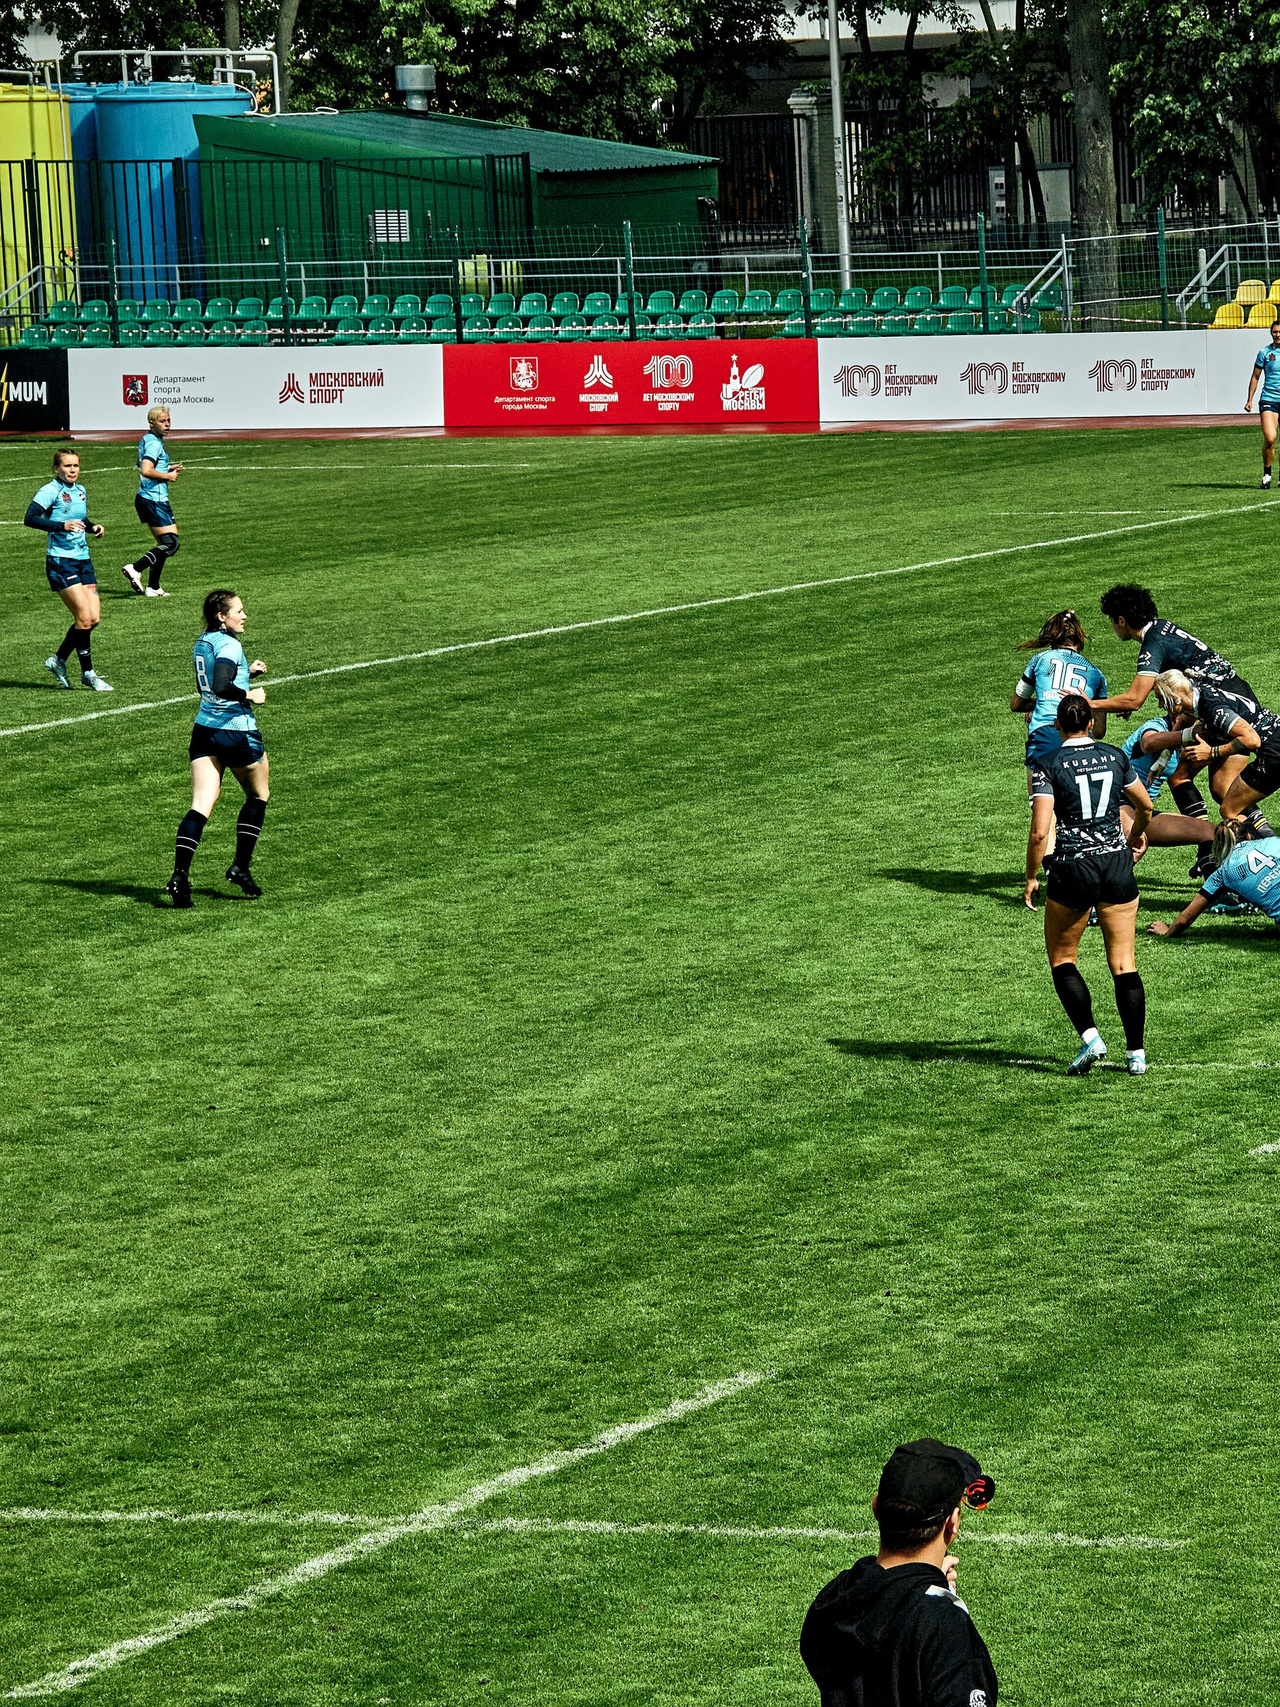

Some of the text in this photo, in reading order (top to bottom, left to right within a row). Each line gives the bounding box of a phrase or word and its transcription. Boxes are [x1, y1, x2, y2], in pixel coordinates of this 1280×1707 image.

[885, 364, 898, 374] ЛЕТ
[1012, 362, 1025, 372] ЛЕТ
[1141, 359, 1154, 369] ЛЕТ
[643, 355, 693, 388] 100
[1088, 359, 1137, 392] 100
[1141, 369, 1195, 380] МОСКОВСКОМУ
[153, 375, 206, 384] Департамент
[309, 368, 384, 387] МОСКОВСКИЙ
[833, 364, 881, 397] 100
[885, 375, 938, 386] МОСКОВСКОМУ
[959, 362, 1008, 395] 100
[1012, 372, 1066, 383] МОСКОВСКОМУ
[1012, 384, 1040, 394] СПОРТУ
[1141, 380, 1169, 391] СПОРТУ
[309, 389, 344, 404] СПОРТ
[579, 392, 619, 402] МОСКОВСКИЙ
[643, 393, 695, 401] ЛЕТ МОСКОВСКОМУ
[740, 390, 765, 401] РЕГБИ
[885, 386, 912, 397] СПОРТУ
[589, 403, 609, 411] СПОРТ
[658, 402, 680, 410] СПОРТУ
[723, 400, 766, 411] МОСКВЫ
[194, 654, 211, 692] 8
[1050, 658, 1087, 695] 16
[1074, 770, 1113, 820] 17
[1247, 848, 1277, 875] 4
